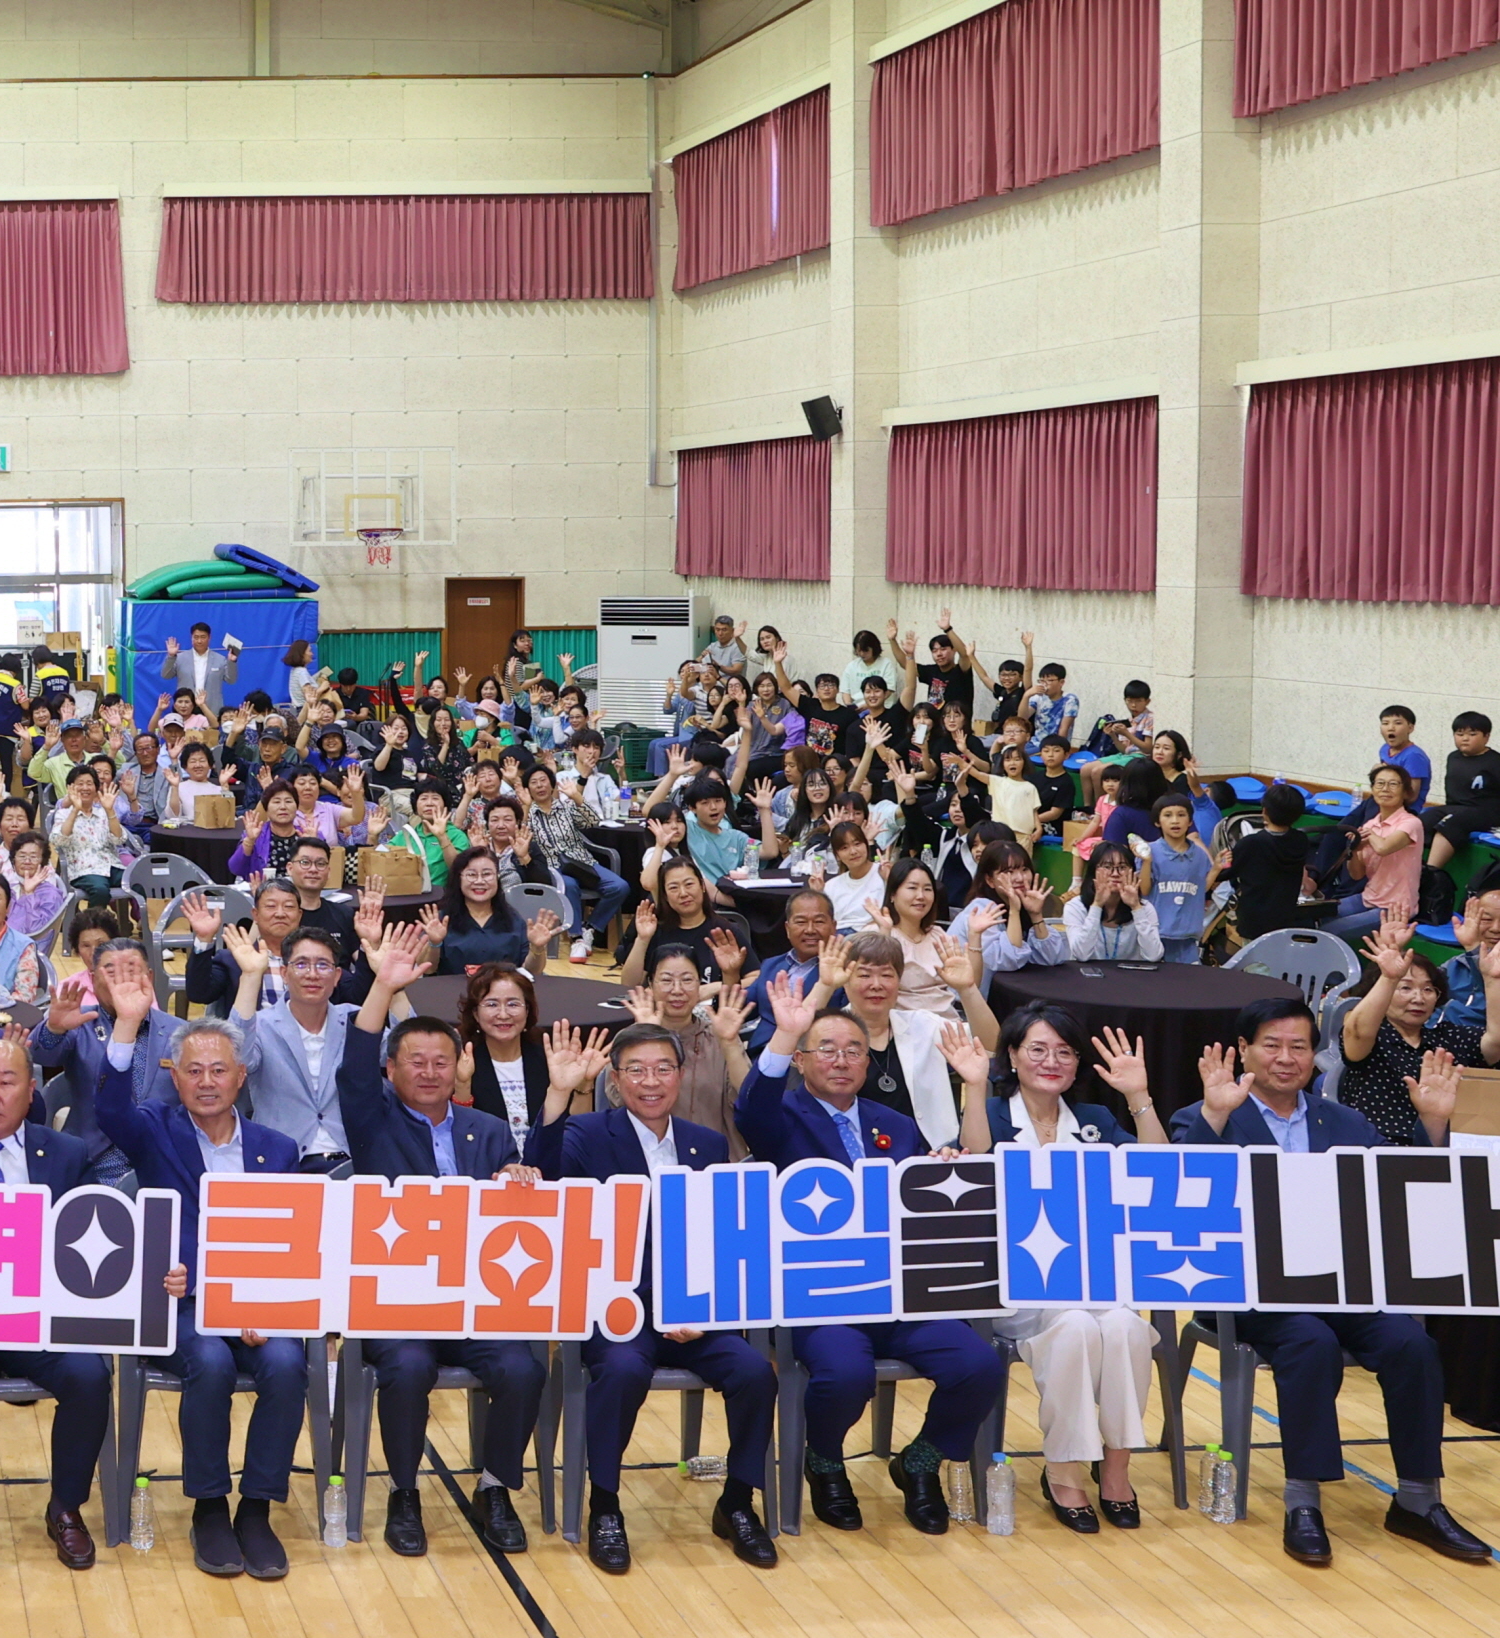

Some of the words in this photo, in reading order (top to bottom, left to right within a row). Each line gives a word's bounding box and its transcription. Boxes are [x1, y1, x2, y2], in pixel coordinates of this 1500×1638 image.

[205, 1182, 321, 1330] 큰
[348, 1182, 643, 1335] 변화!
[662, 1158, 1000, 1326] 내일을
[1004, 1150, 1500, 1306] 바꿉니다
